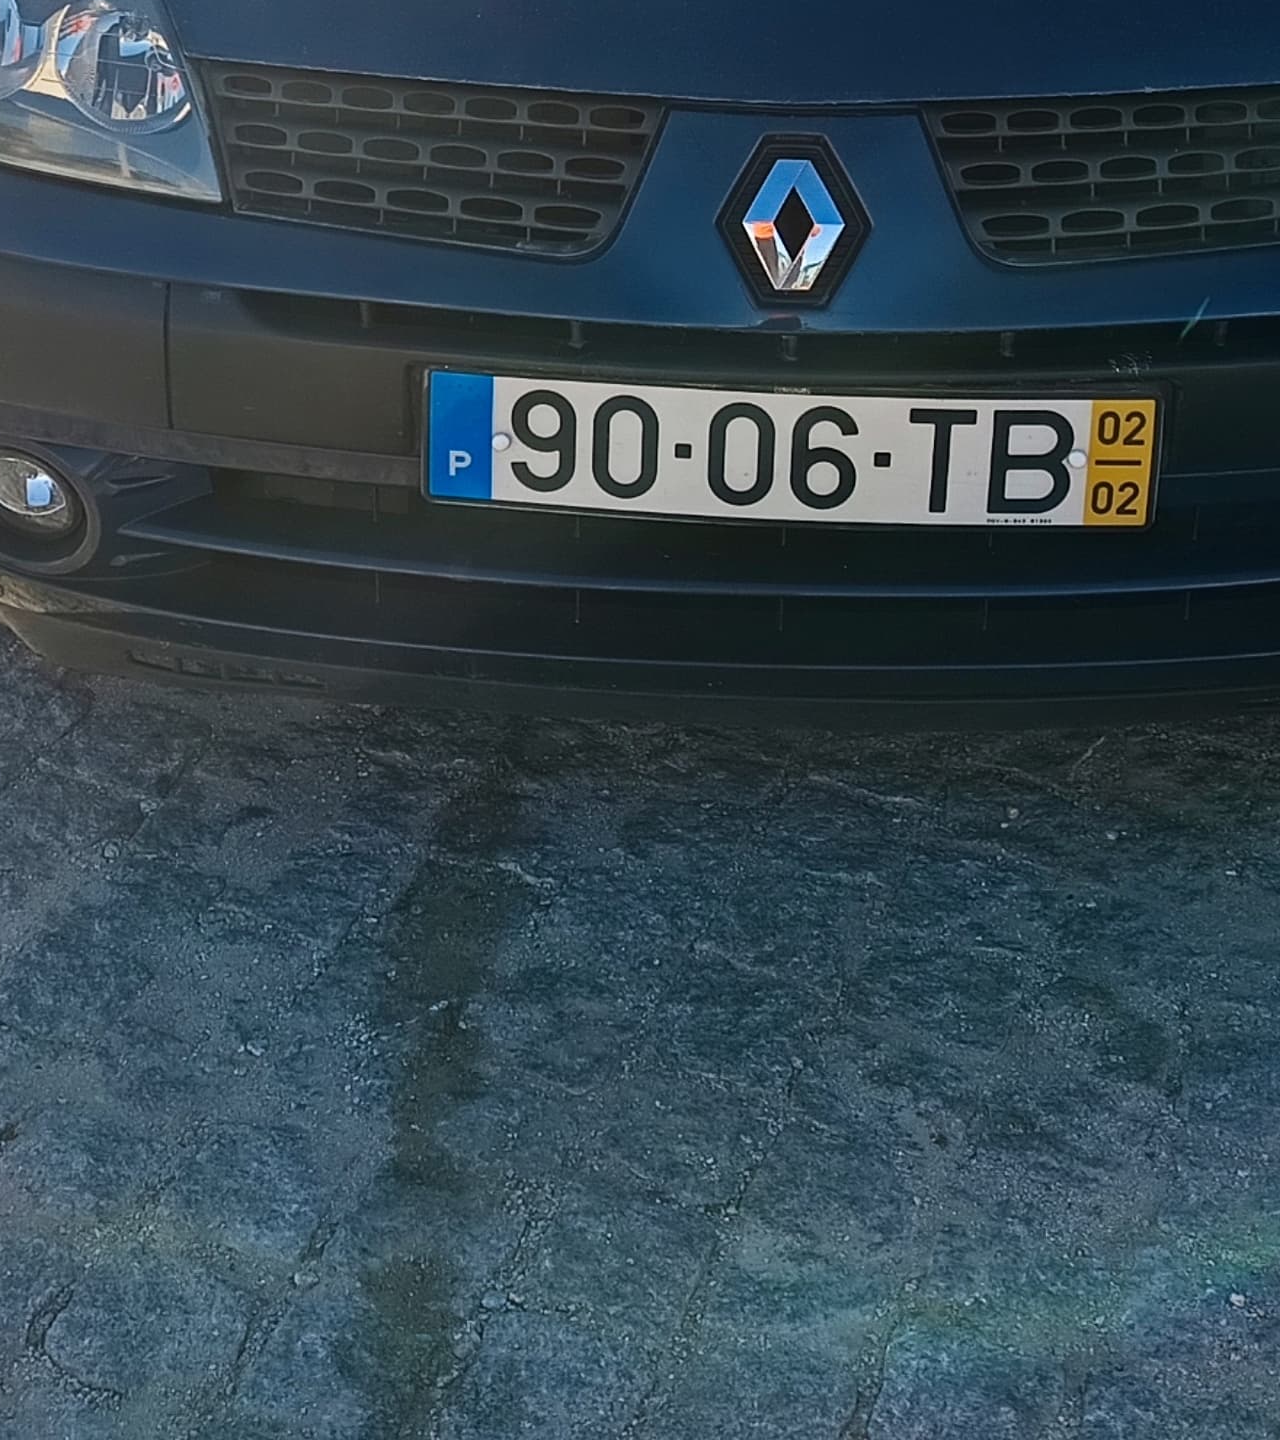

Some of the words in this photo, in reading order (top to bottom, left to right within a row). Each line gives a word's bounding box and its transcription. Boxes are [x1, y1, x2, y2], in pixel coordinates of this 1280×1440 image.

[1097, 410, 1147, 447] 02
[448, 449, 472, 477] P
[1091, 480, 1140, 516] 02
